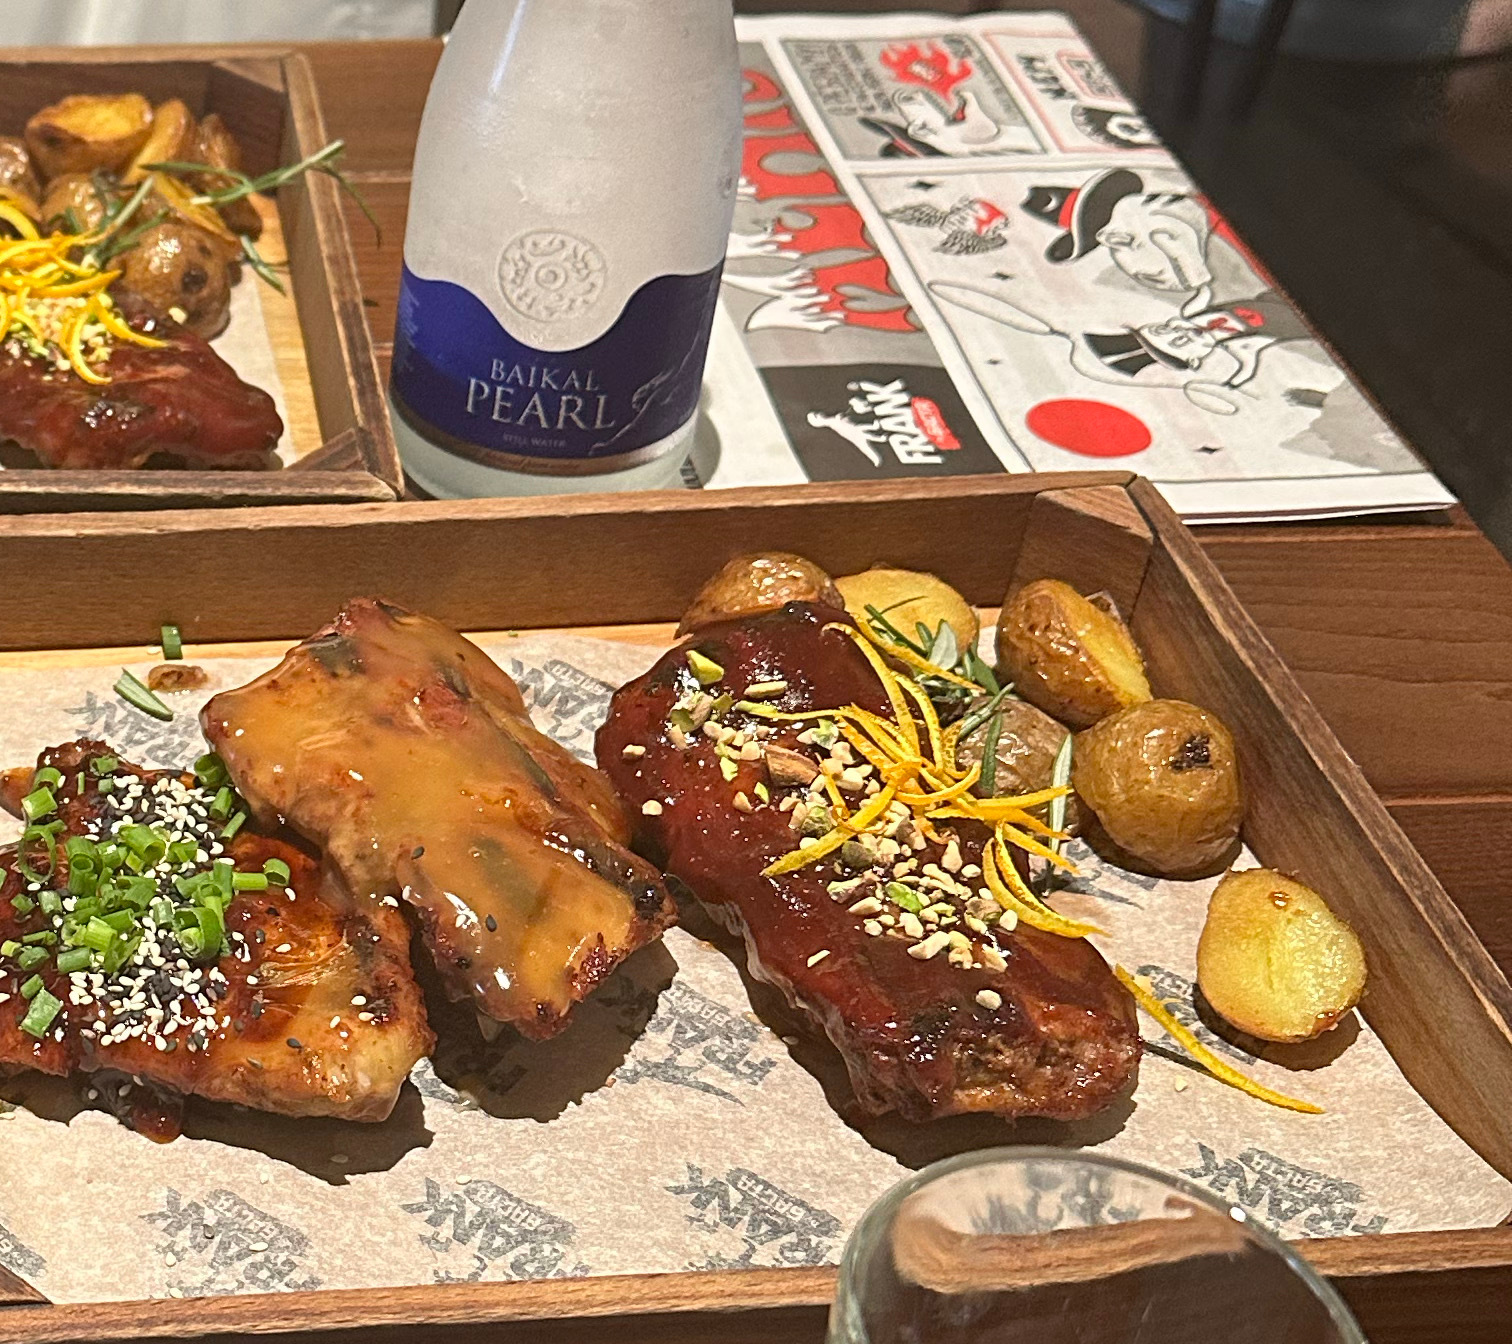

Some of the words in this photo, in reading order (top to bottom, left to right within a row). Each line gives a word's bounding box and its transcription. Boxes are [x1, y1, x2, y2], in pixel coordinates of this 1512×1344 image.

[490, 358, 600, 392] BAIKAL
[465, 376, 616, 431] PEARL
[858, 377, 945, 464] FRANK
[531, 437, 566, 448] WATER
